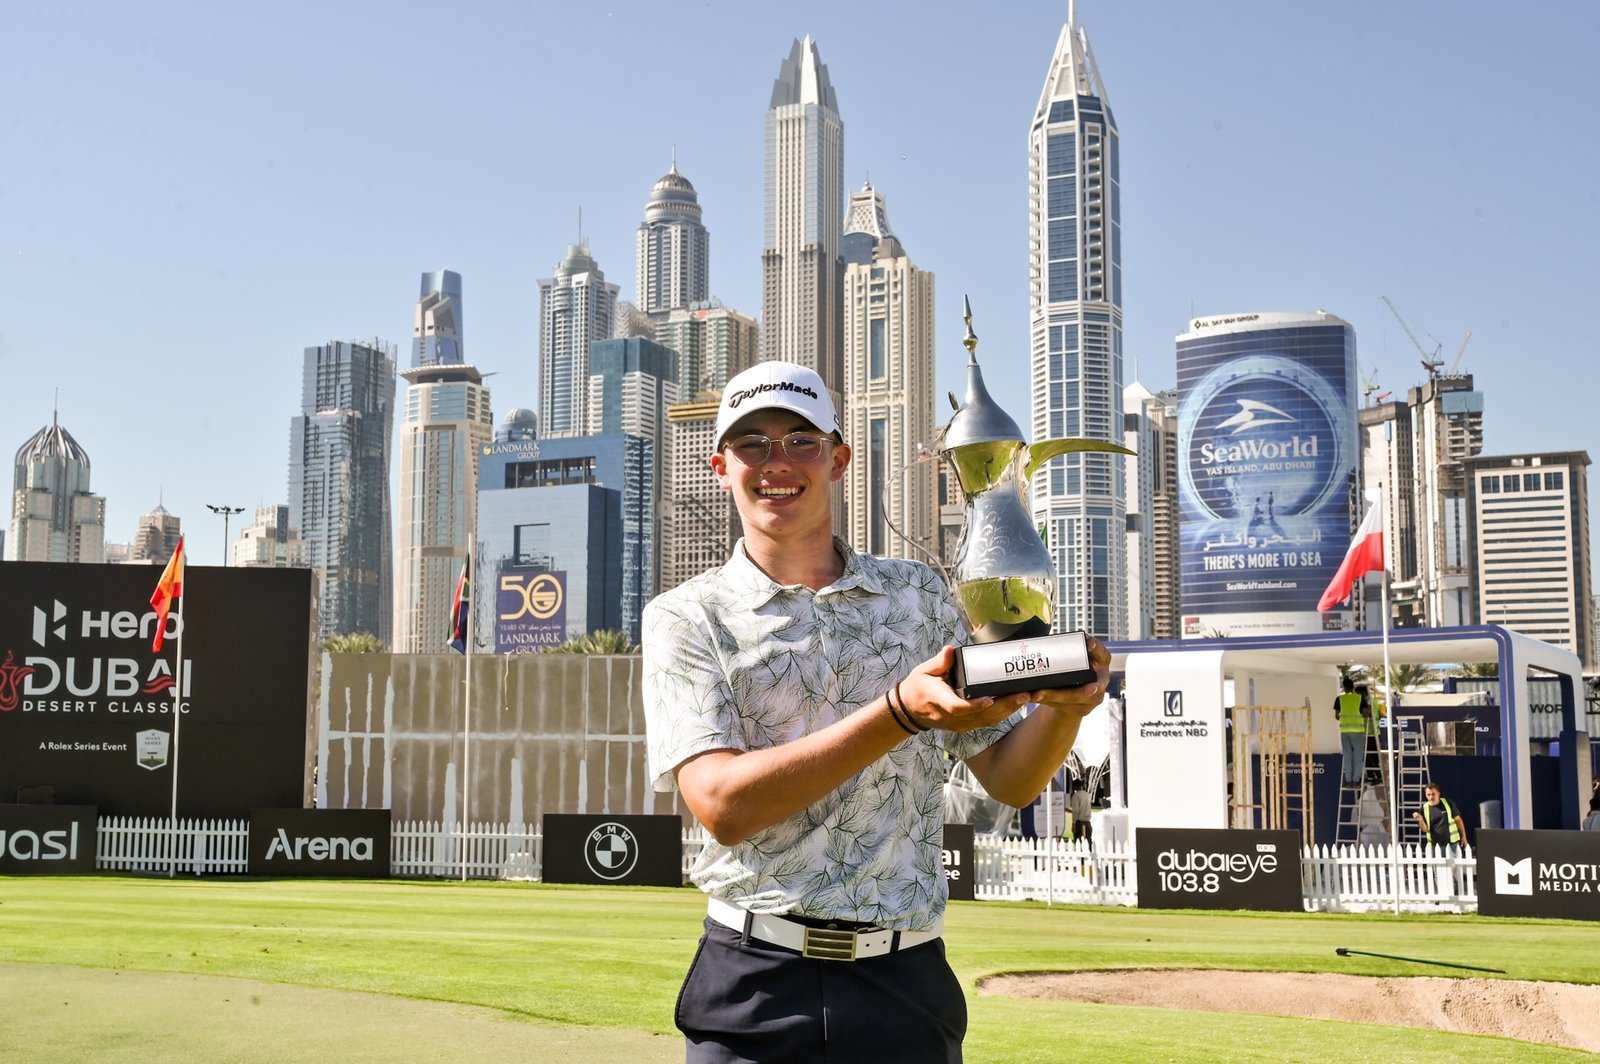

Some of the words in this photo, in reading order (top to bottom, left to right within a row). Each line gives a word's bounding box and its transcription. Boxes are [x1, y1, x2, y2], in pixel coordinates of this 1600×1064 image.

[728, 381, 819, 409] TaylorMade
[492, 442, 540, 455] LANDMARK
[1200, 435, 1319, 465] SeaWorld
[1205, 468, 1222, 476] YAS
[1224, 464, 1260, 474] ISLAND,
[1262, 462, 1282, 472] ABU
[1285, 460, 1317, 470] DHABI
[1203, 553, 1246, 571] THERE'S
[1247, 553, 1280, 569] MORE
[1281, 552, 1298, 567] TO
[1300, 551, 1323, 567] SEA
[1226, 580, 1298, 591] SeaWorldYasIsland.com
[500, 573, 563, 620] 50
[81, 610, 185, 640] Hero
[500, 632, 561, 645] LANDMARK
[1004, 656, 1050, 674] DUBAI
[1011, 652, 1042, 662] JUNIOR
[23, 656, 192, 698] DUBAI
[22, 700, 97, 712] DESERT
[108, 701, 191, 714] CLASSIC
[1529, 703, 1564, 714] WOR
[1140, 728, 1183, 738] Emirates
[1185, 728, 1209, 737] NBD
[39, 742, 46, 750] A
[48, 742, 72, 751] Rolex
[74, 742, 101, 751] Series
[102, 742, 127, 751] Event
[0, 821, 79, 861] asl
[592, 825, 631, 842] BMW
[264, 828, 374, 861] Arena
[1538, 862, 1600, 881] MOTI
[1158, 871, 1220, 893] 103.8
[1539, 880, 1592, 893] MEDIA
